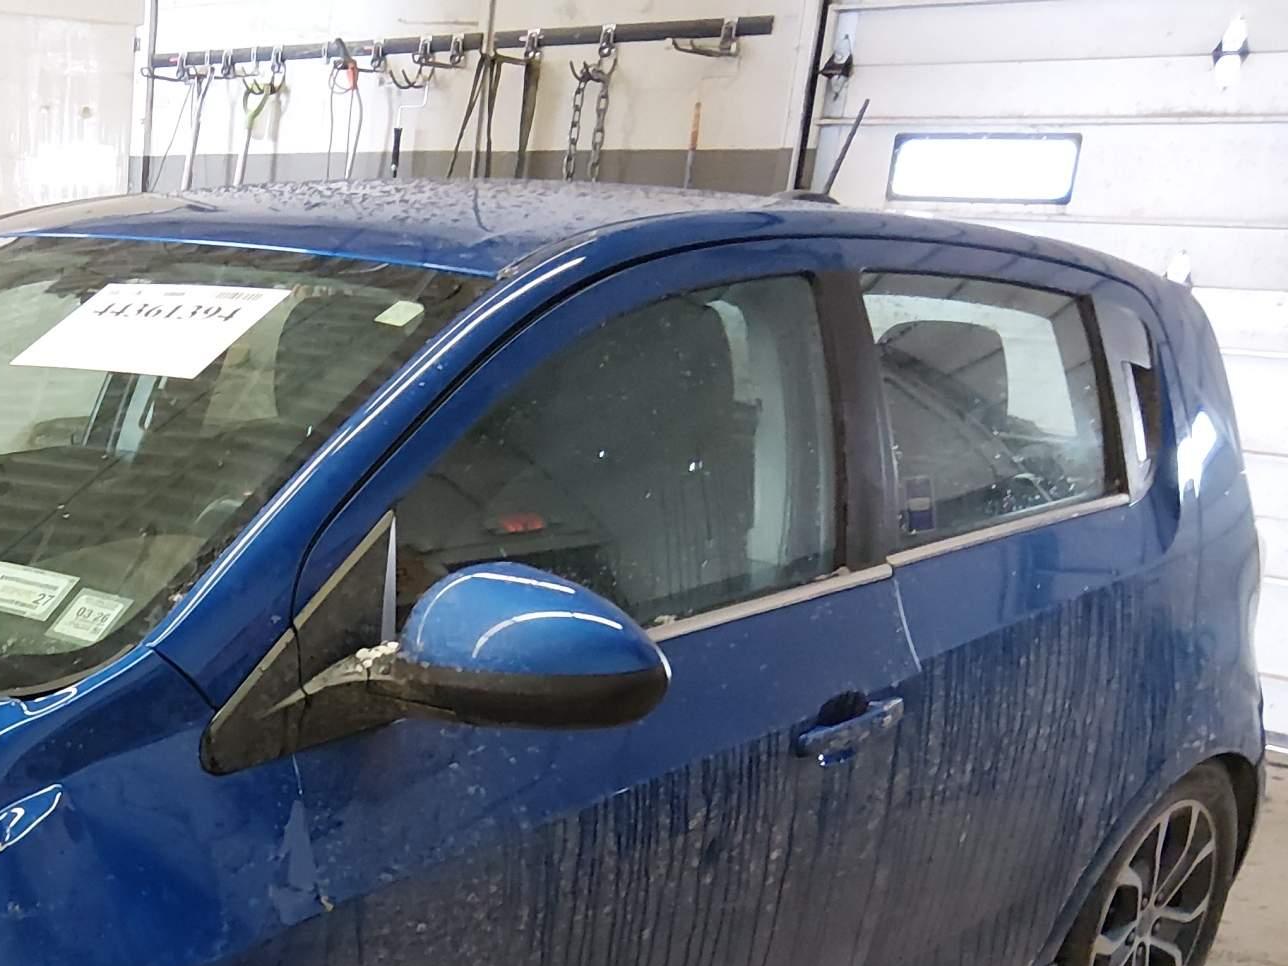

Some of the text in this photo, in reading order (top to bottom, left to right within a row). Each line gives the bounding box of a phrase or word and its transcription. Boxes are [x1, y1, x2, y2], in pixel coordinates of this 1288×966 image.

[93, 303, 241, 321] 44361394
[32, 593, 55, 606] 27
[76, 607, 111, 623] 03 26
